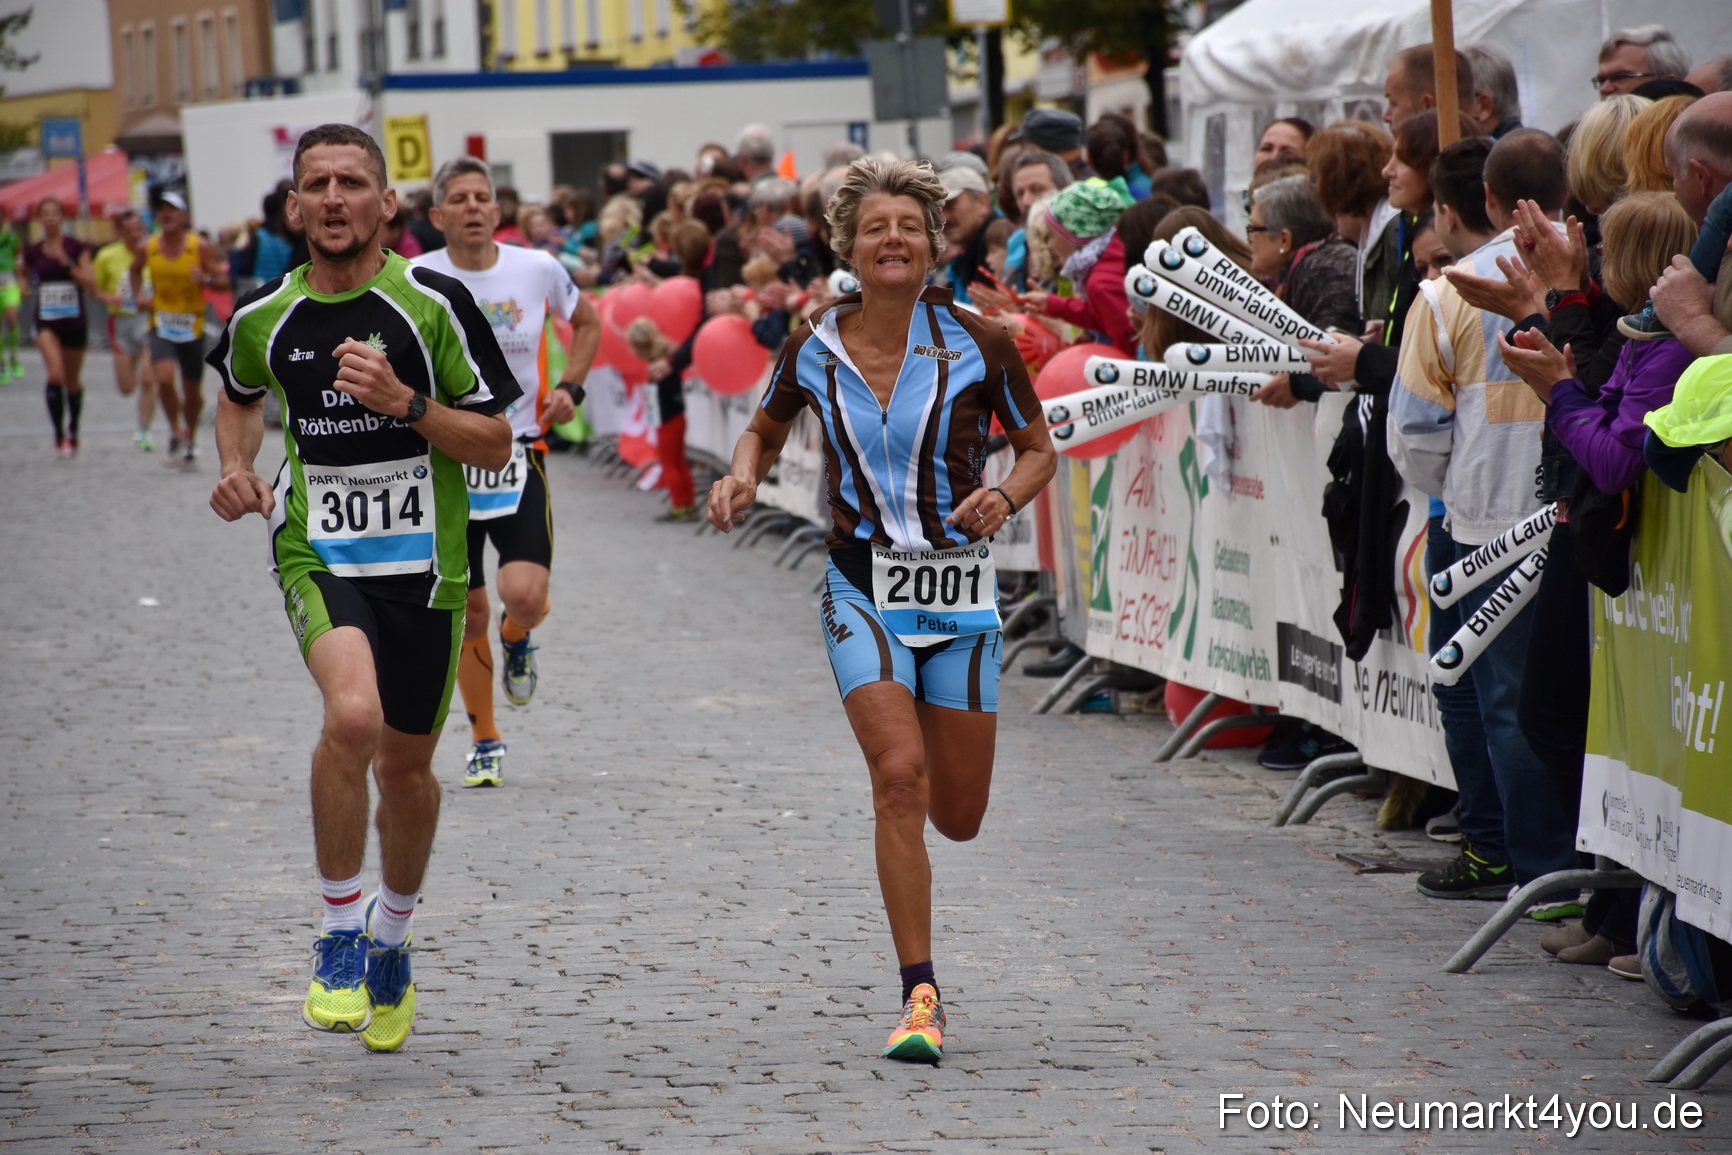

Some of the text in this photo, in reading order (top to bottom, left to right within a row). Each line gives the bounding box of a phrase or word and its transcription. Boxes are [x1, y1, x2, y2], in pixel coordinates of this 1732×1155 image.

[400, 136, 421, 168] D
[1166, 291, 1220, 330] BMW
[1194, 266, 1325, 342] bmw-laufsport
[1226, 346, 1281, 362] BMW
[1133, 368, 1188, 389] BMW
[321, 388, 363, 408] DA
[309, 470, 409, 487] PARTL Neumarkt
[321, 486, 424, 534] 3014
[876, 549, 976, 562] PARTL Neumarkt
[1462, 533, 1509, 578] BMW
[887, 564, 981, 606] 2001
[1466, 576, 1521, 637] BMW
[916, 614, 958, 632] Petra
